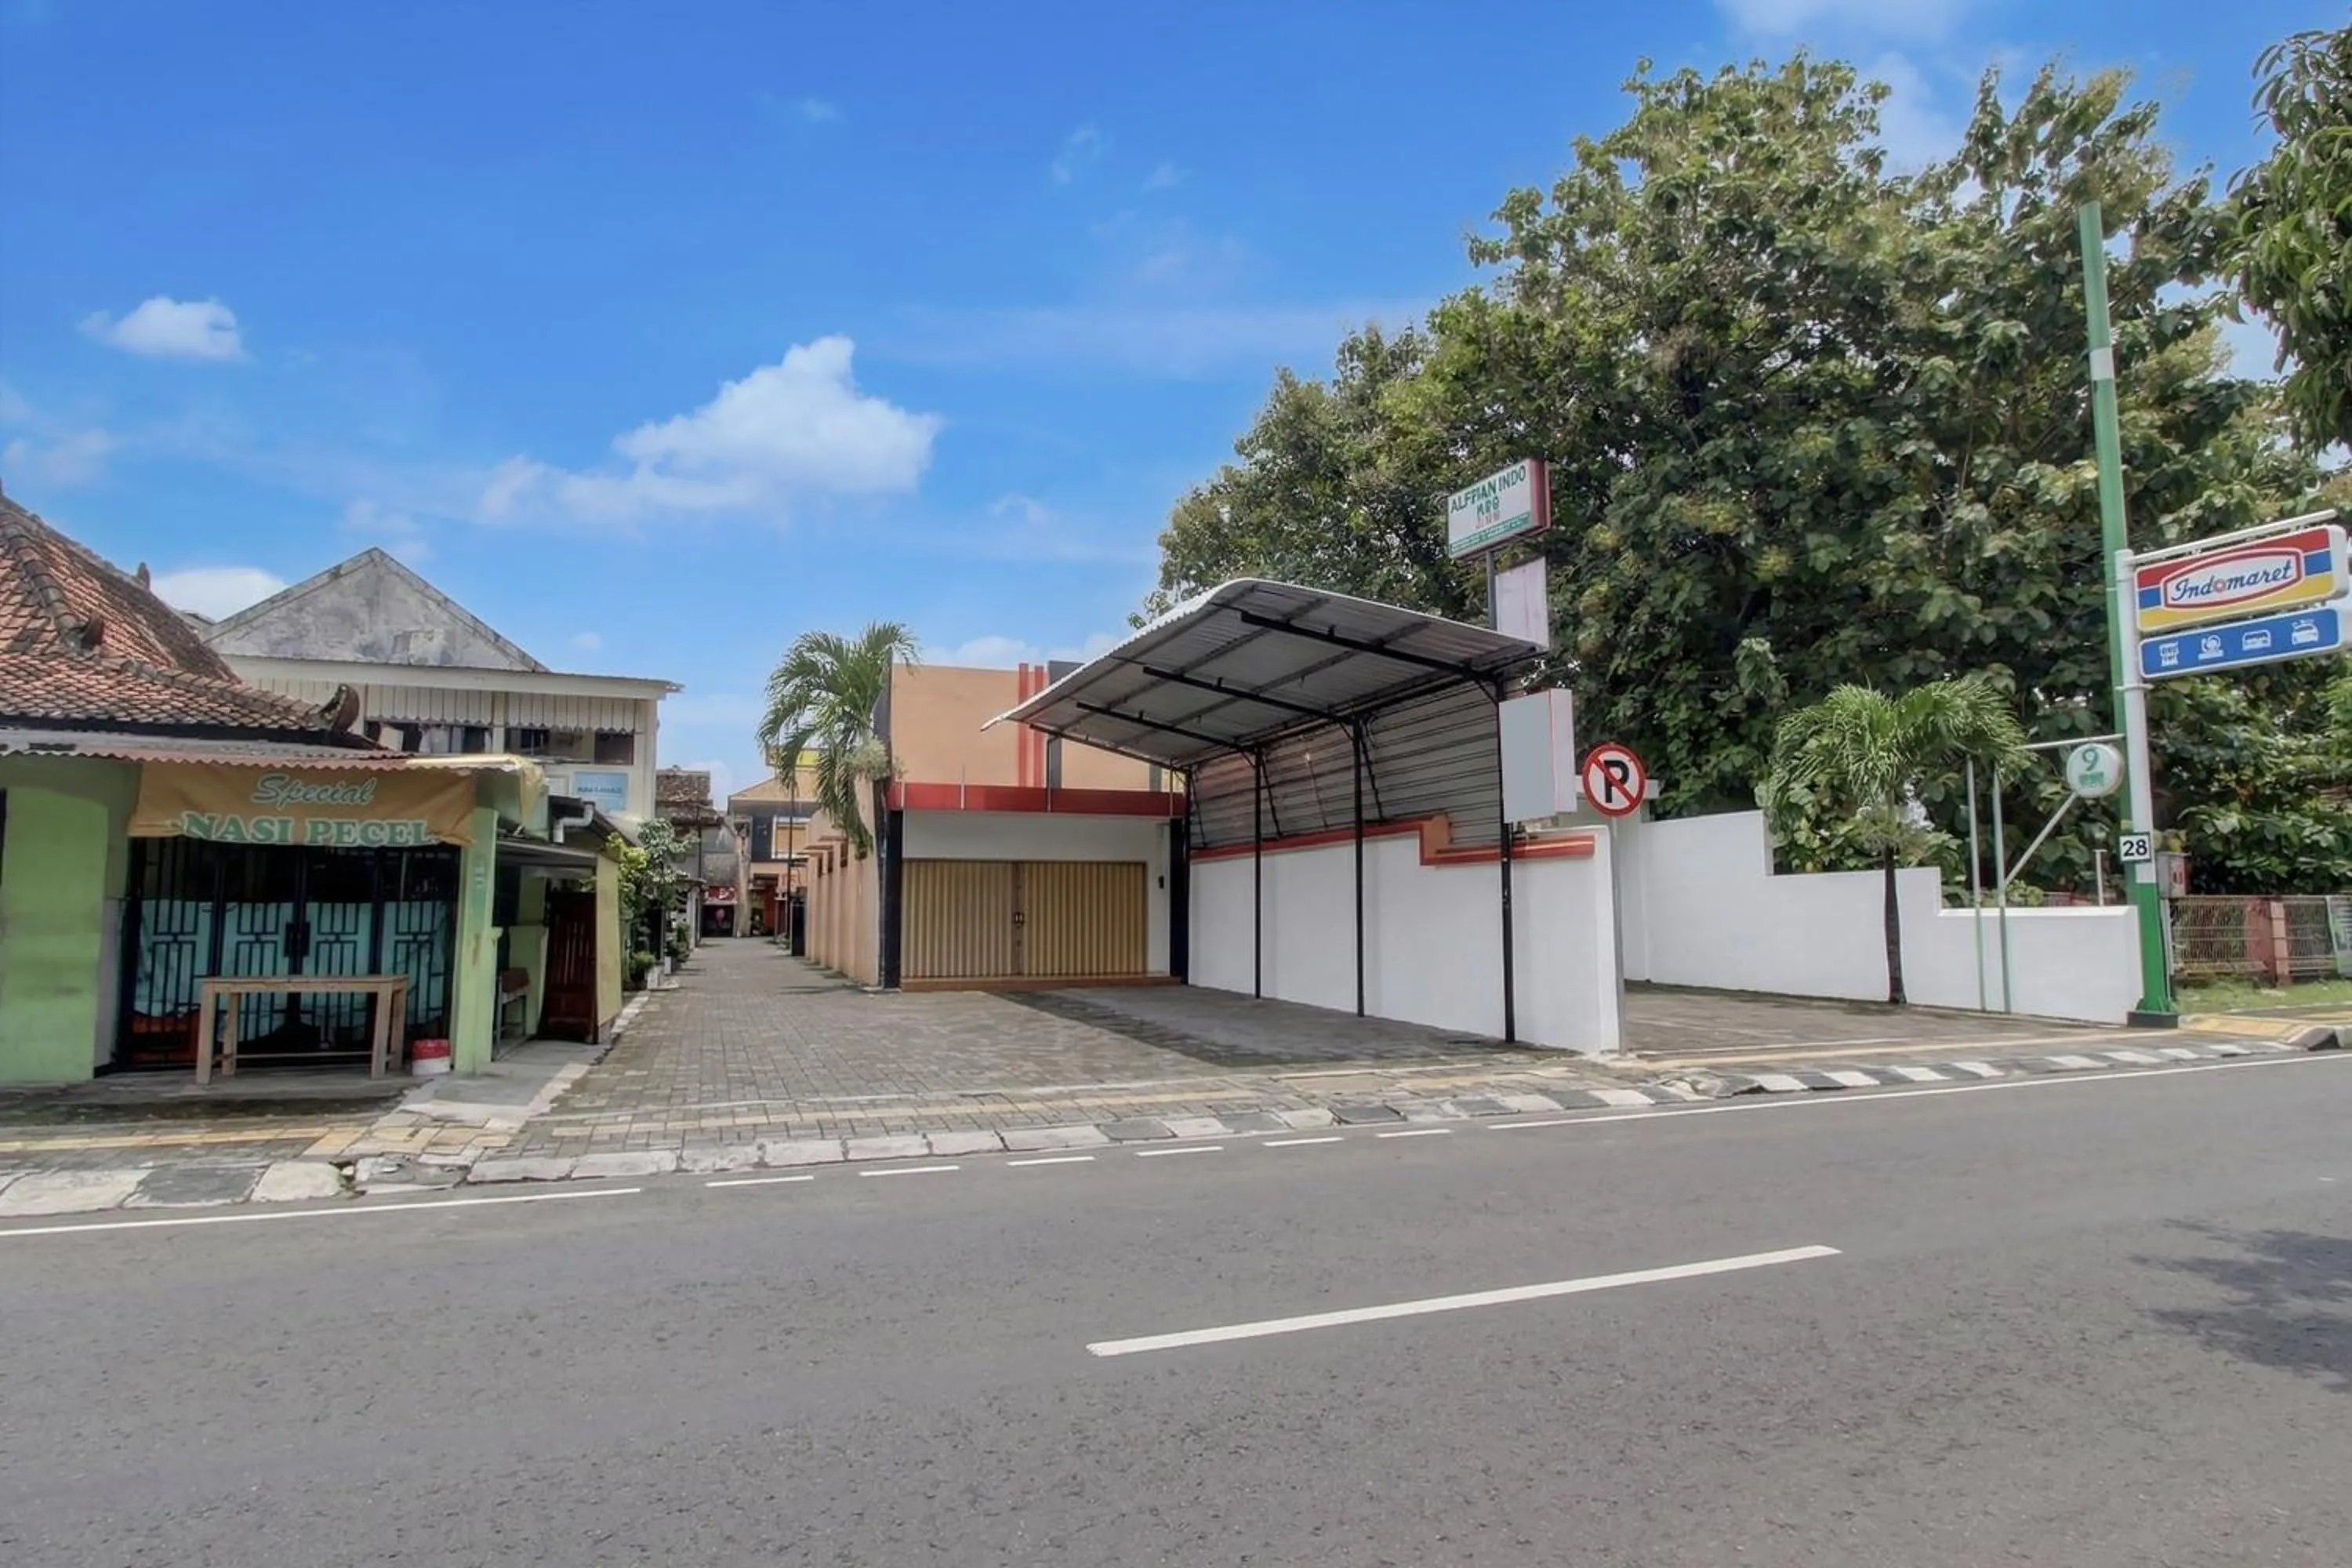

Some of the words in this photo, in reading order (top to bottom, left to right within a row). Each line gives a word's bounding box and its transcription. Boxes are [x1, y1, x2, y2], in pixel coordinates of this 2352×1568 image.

[1498, 464, 1526, 492] INDO
[2171, 560, 2292, 601] Indomaret
[2082, 748, 2099, 771] 9
[252, 773, 377, 811] Special
[1604, 760, 1629, 803] P
[182, 811, 293, 845] NASI
[306, 817, 433, 847] PECEL
[2122, 840, 2147, 856] 28
